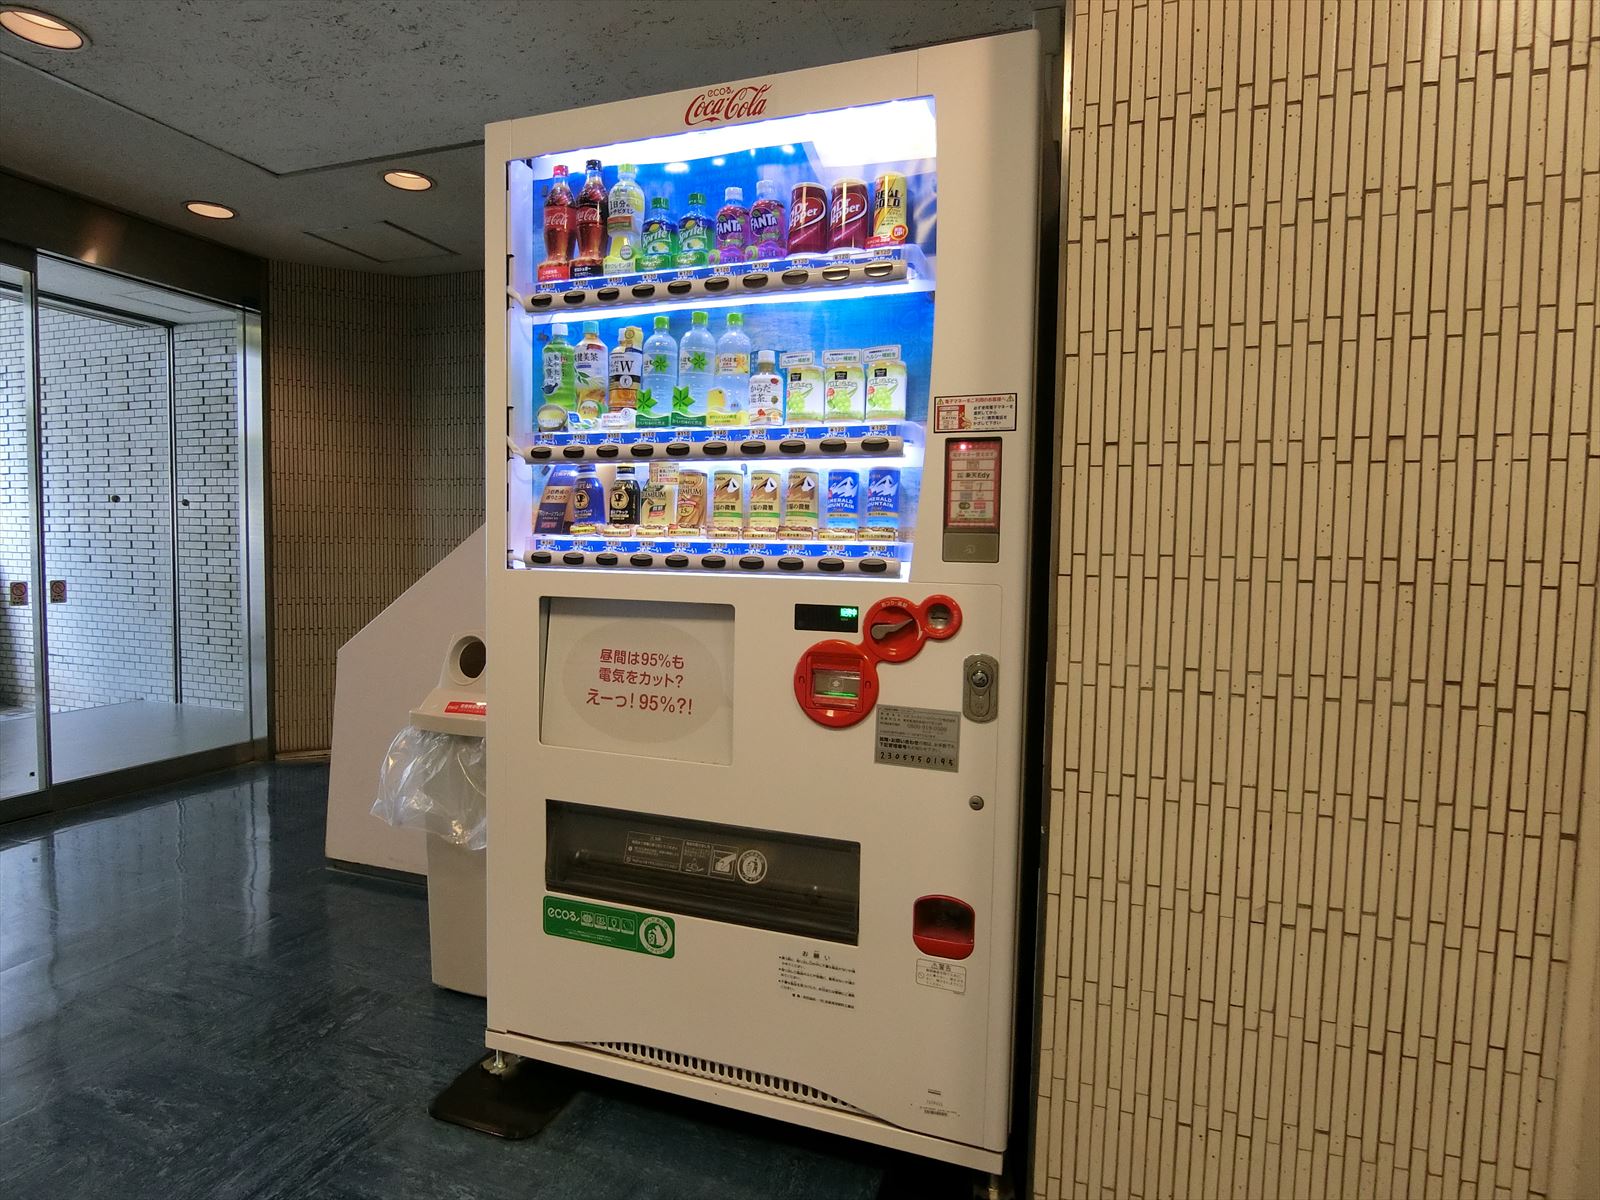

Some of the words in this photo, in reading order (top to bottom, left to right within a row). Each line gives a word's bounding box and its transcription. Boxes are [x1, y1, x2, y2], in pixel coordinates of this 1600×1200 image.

[716, 220, 742, 235] FANTA
[751, 213, 778, 231] FANTA
[620, 360, 634, 373] W
[600, 648, 685, 670] 昼間は95%も
[599, 667, 684, 689] 電気をカット?
